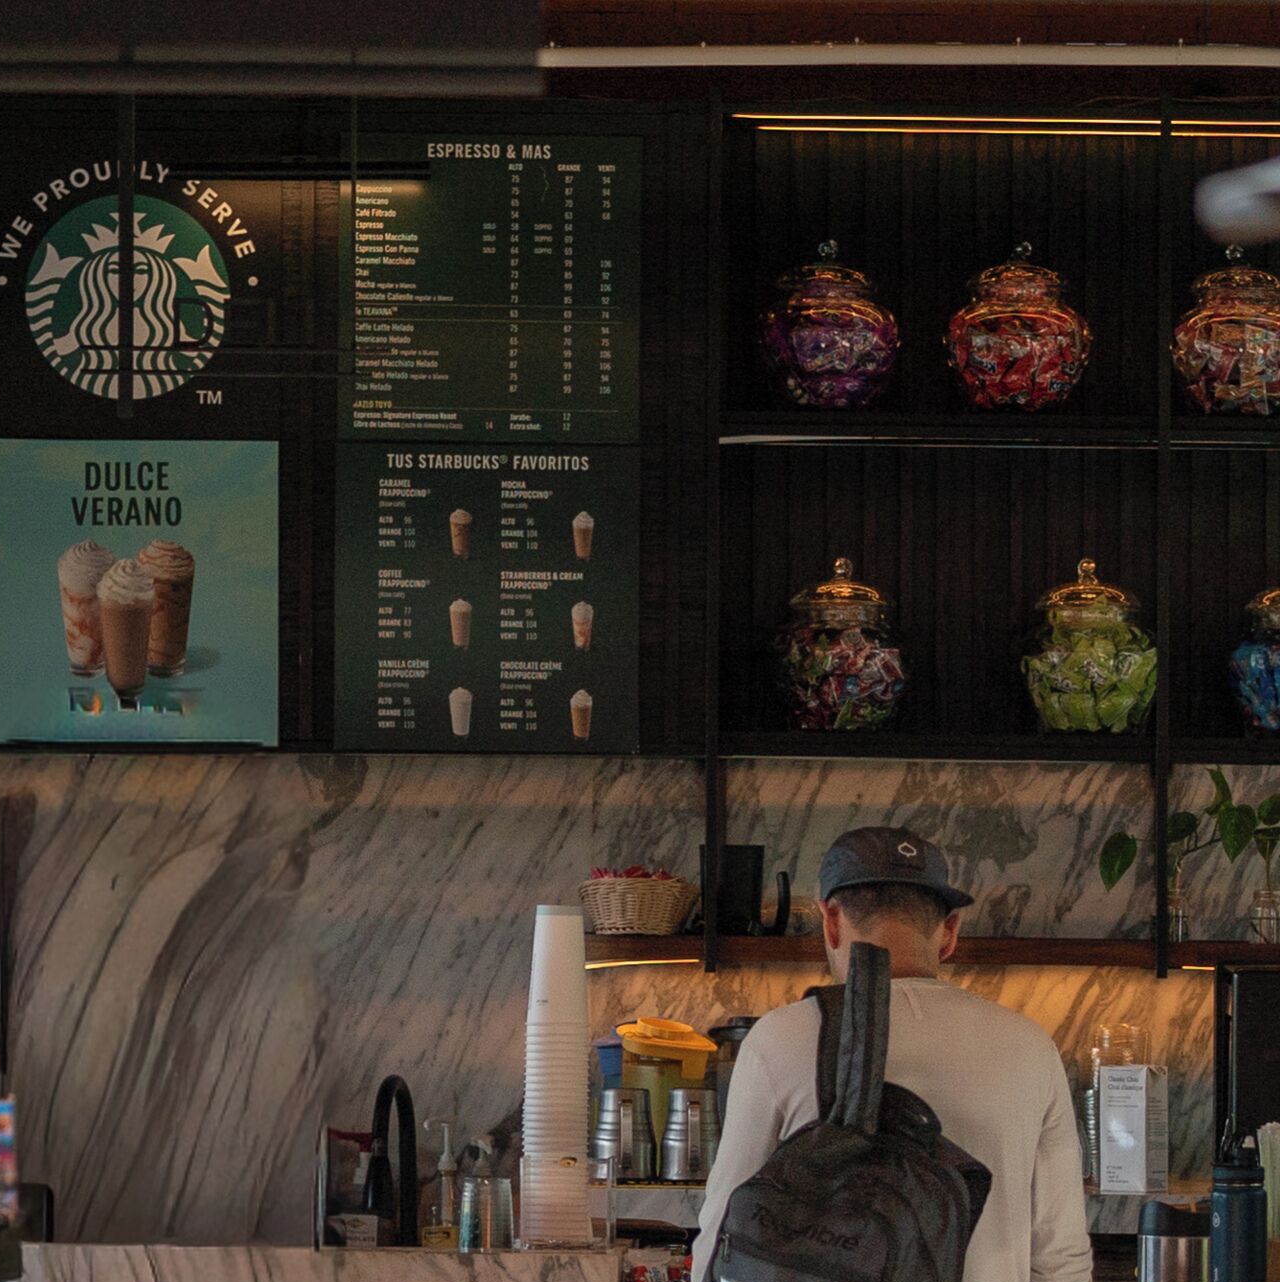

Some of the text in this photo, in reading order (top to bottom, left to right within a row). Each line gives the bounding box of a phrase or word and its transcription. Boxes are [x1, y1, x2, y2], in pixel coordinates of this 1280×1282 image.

[427, 143, 551, 159] ESPRESSO & MAS
[557, 163, 581, 172] GRANDE
[598, 164, 616, 173] VENTI
[32, 160, 170, 212] PROULY
[181, 180, 256, 259] SERVE
[196, 390, 222, 405] TM
[387, 453, 413, 469] TUS
[513, 455, 589, 471] FAVORITOS
[85, 462, 169, 491] DULCE
[379, 478, 411, 488] CARAMEL
[501, 480, 527, 490] MOCHA
[71, 497, 182, 526] VERANO
[378, 569, 402, 578] COFFEE
[500, 571, 584, 581] STRAWBERRIES CREAM
[378, 659, 406, 669] VANILLA
[500, 661, 538, 671] CHOCOLATE
